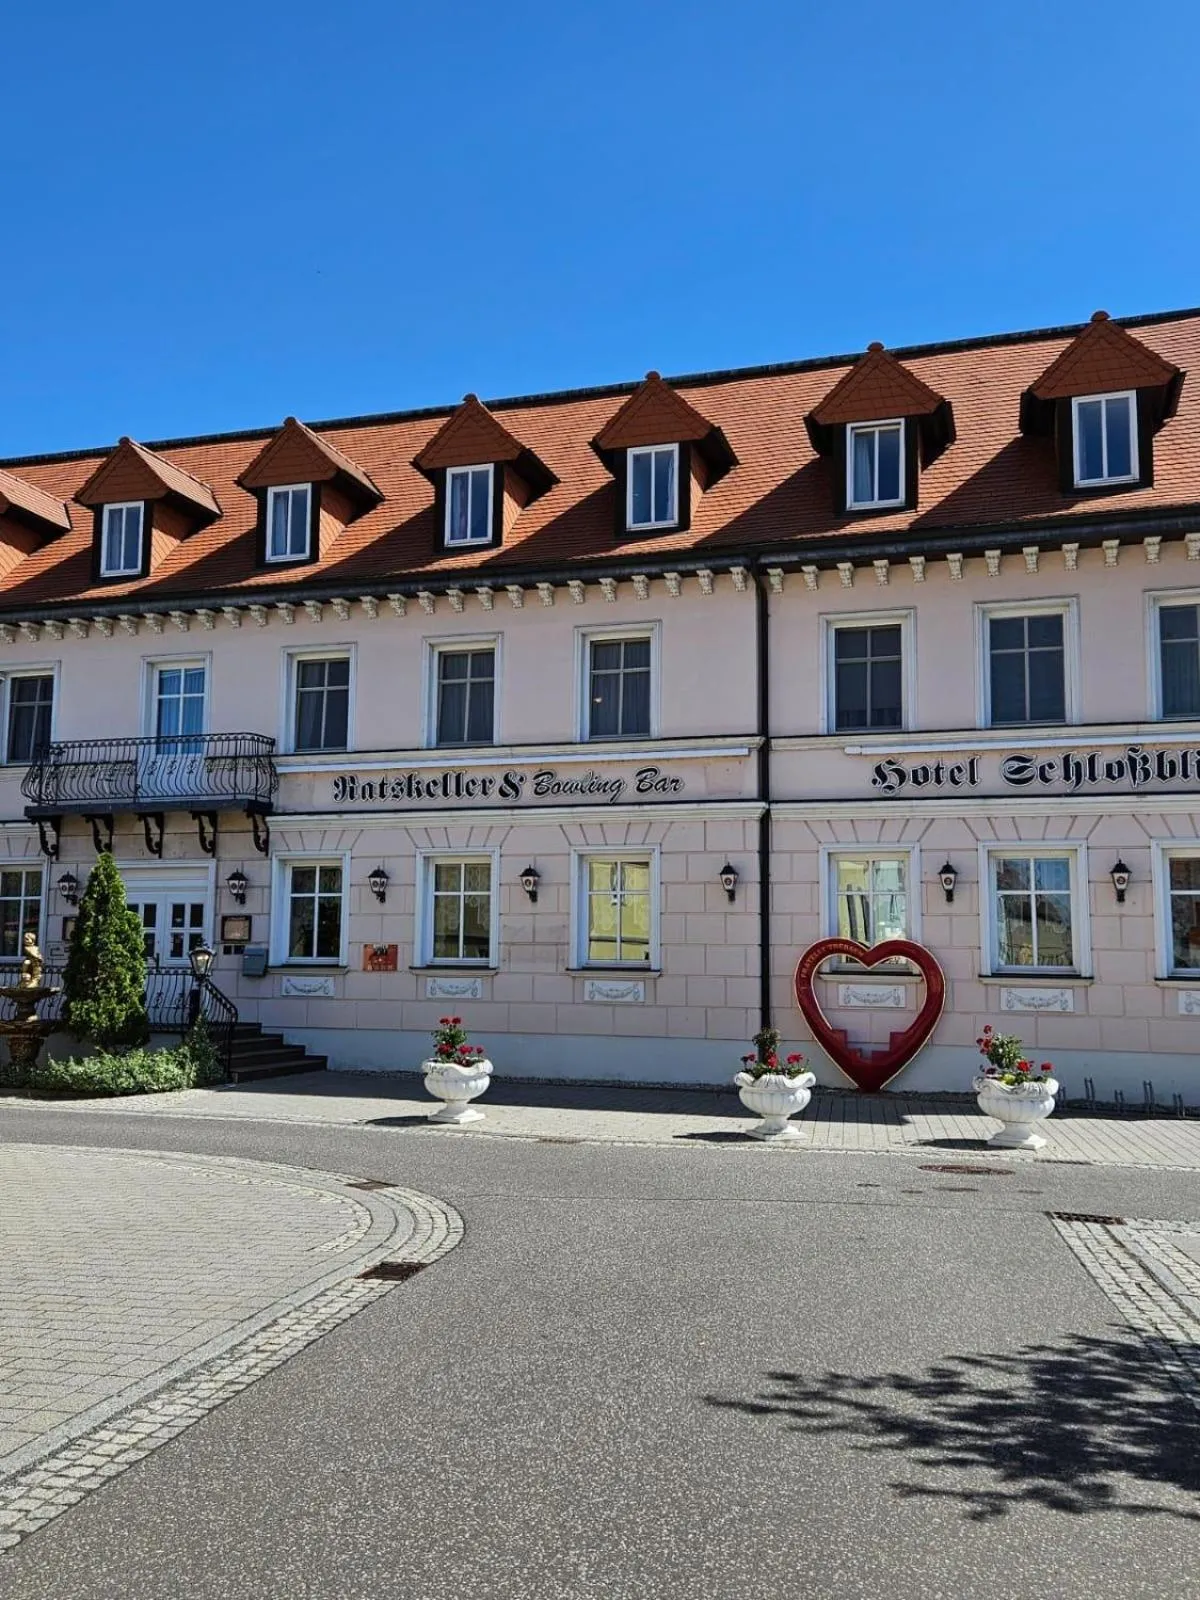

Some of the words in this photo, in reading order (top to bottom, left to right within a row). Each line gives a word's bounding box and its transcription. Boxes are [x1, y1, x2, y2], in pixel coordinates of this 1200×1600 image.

[532, 769, 625, 803] Bowling
[635, 766, 683, 793] Bar
[871, 758, 980, 795] Hotel
